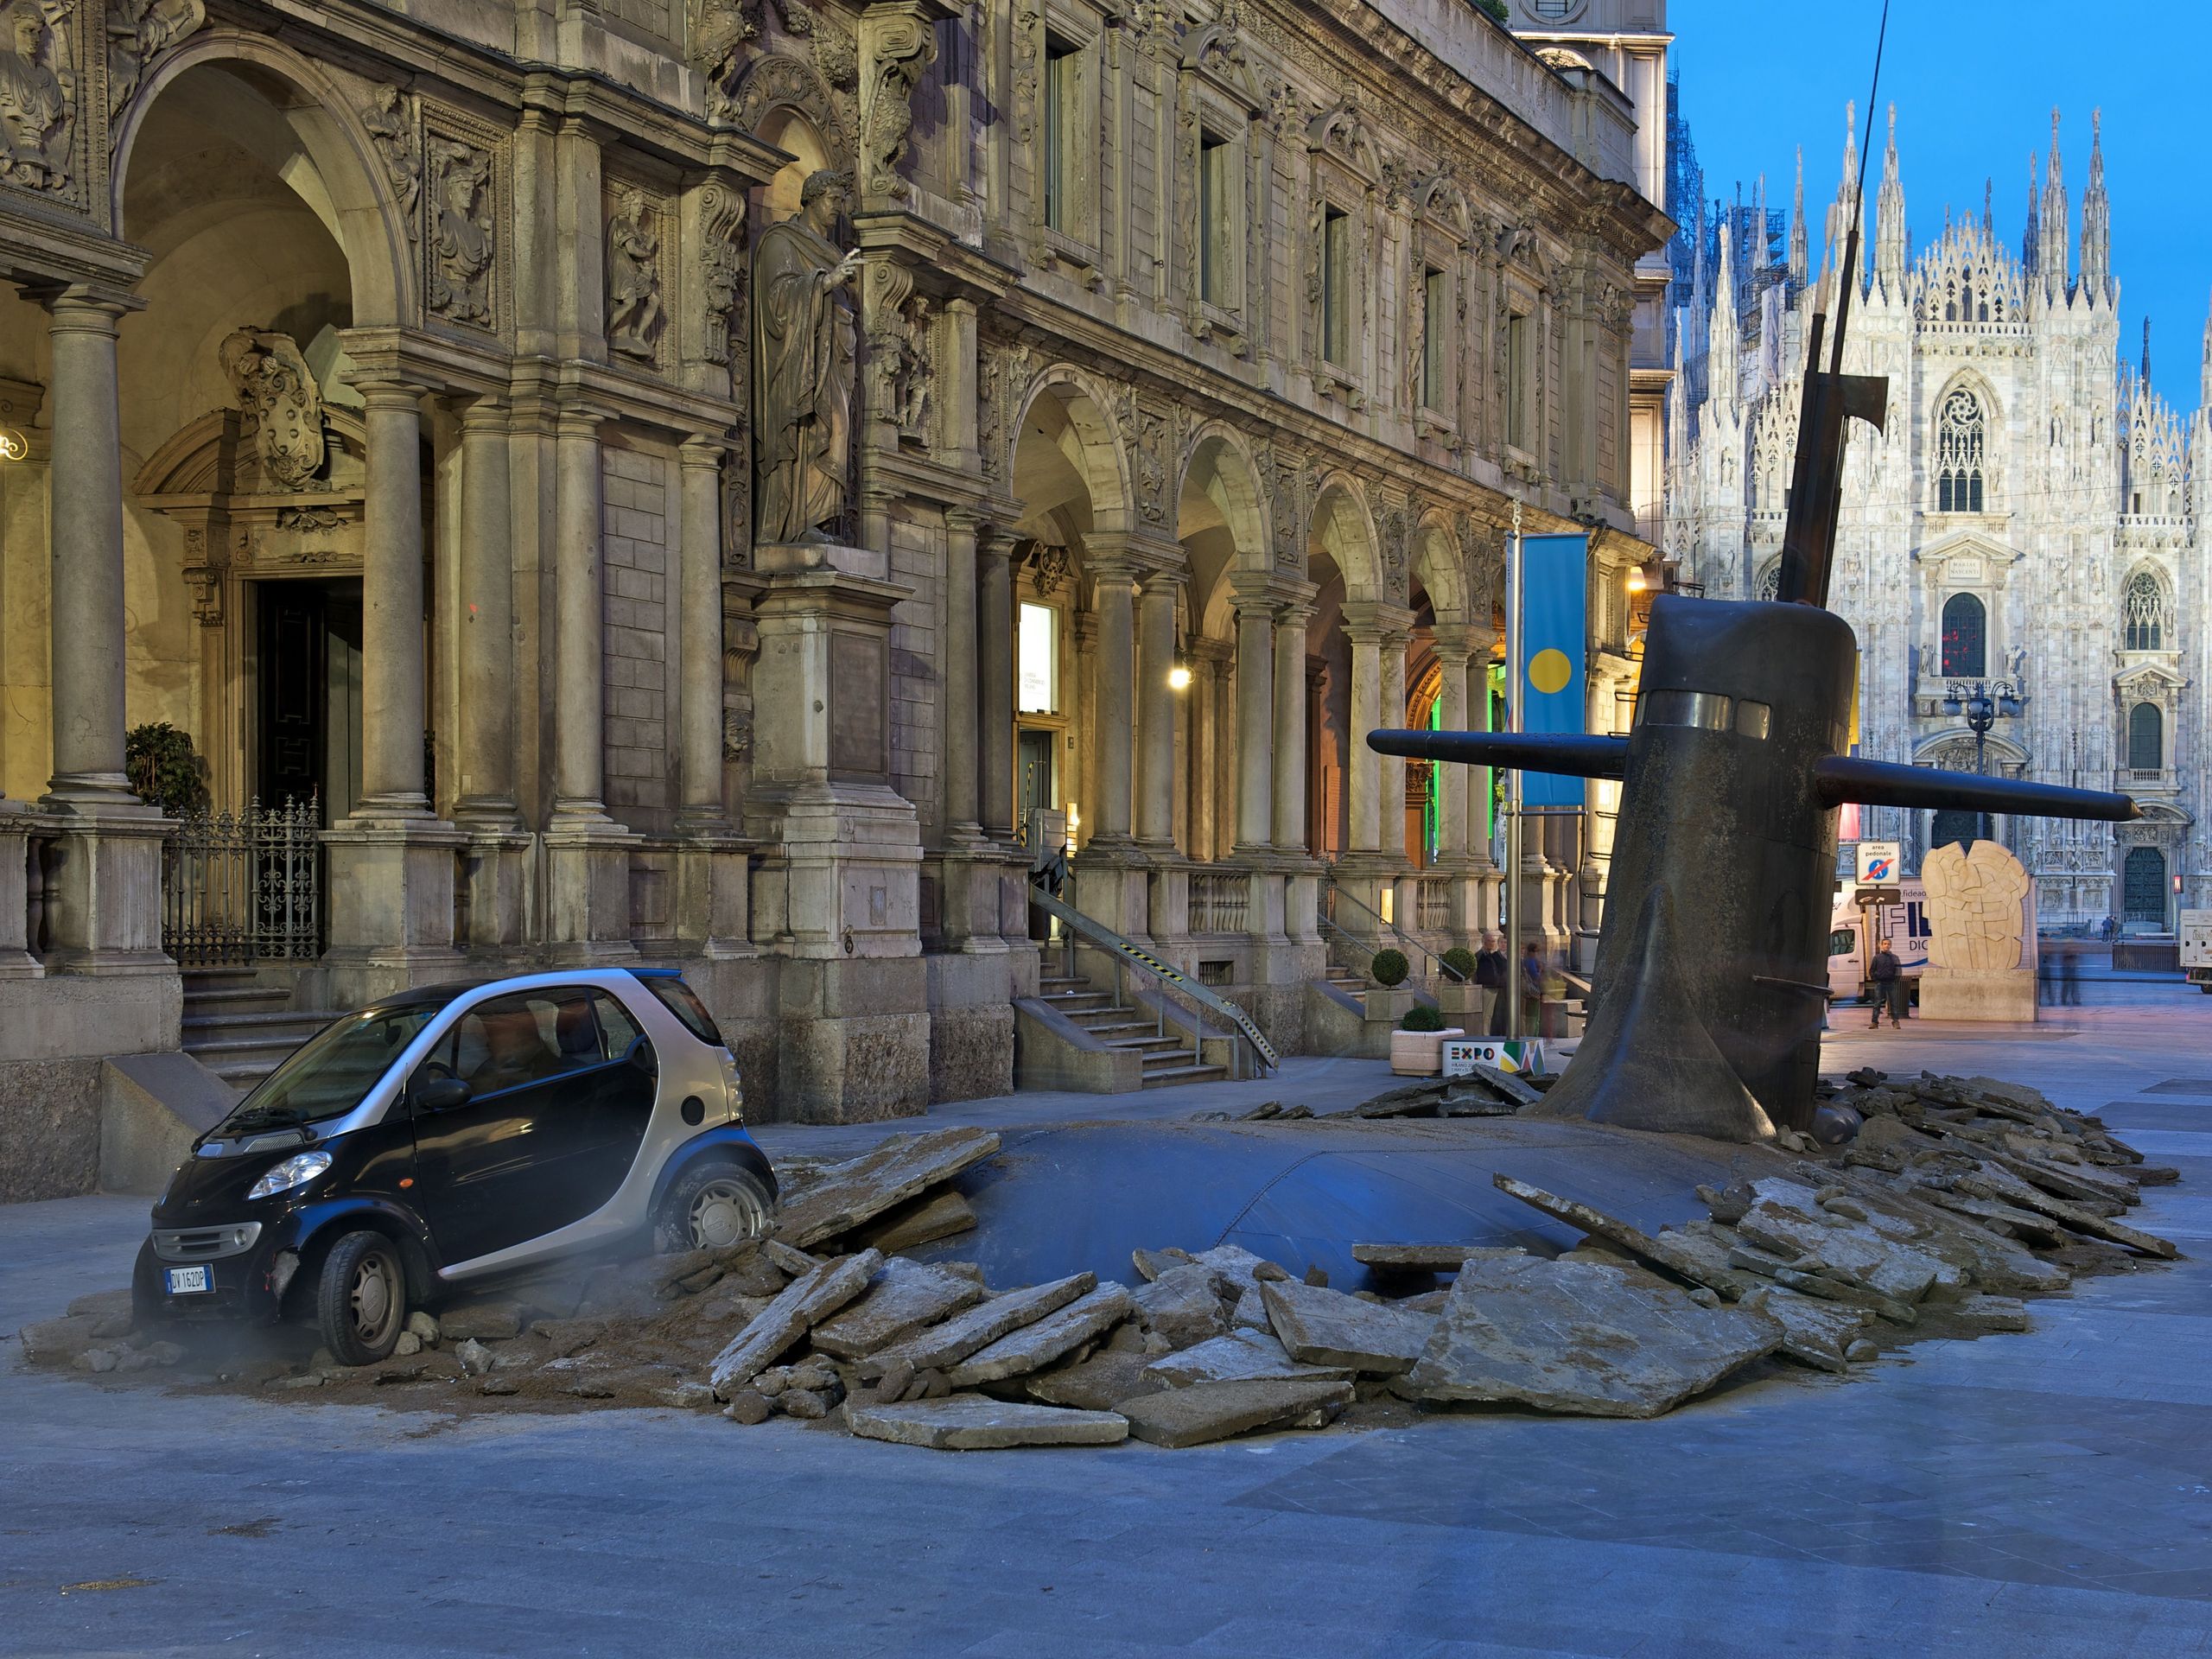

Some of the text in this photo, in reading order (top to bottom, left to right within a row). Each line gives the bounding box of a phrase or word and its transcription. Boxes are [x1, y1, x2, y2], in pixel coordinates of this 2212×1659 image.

[1452, 1047, 1495, 1060] EXPO
[171, 1273, 181, 1289] DV
[182, 1270, 204, 1287] 162DP
